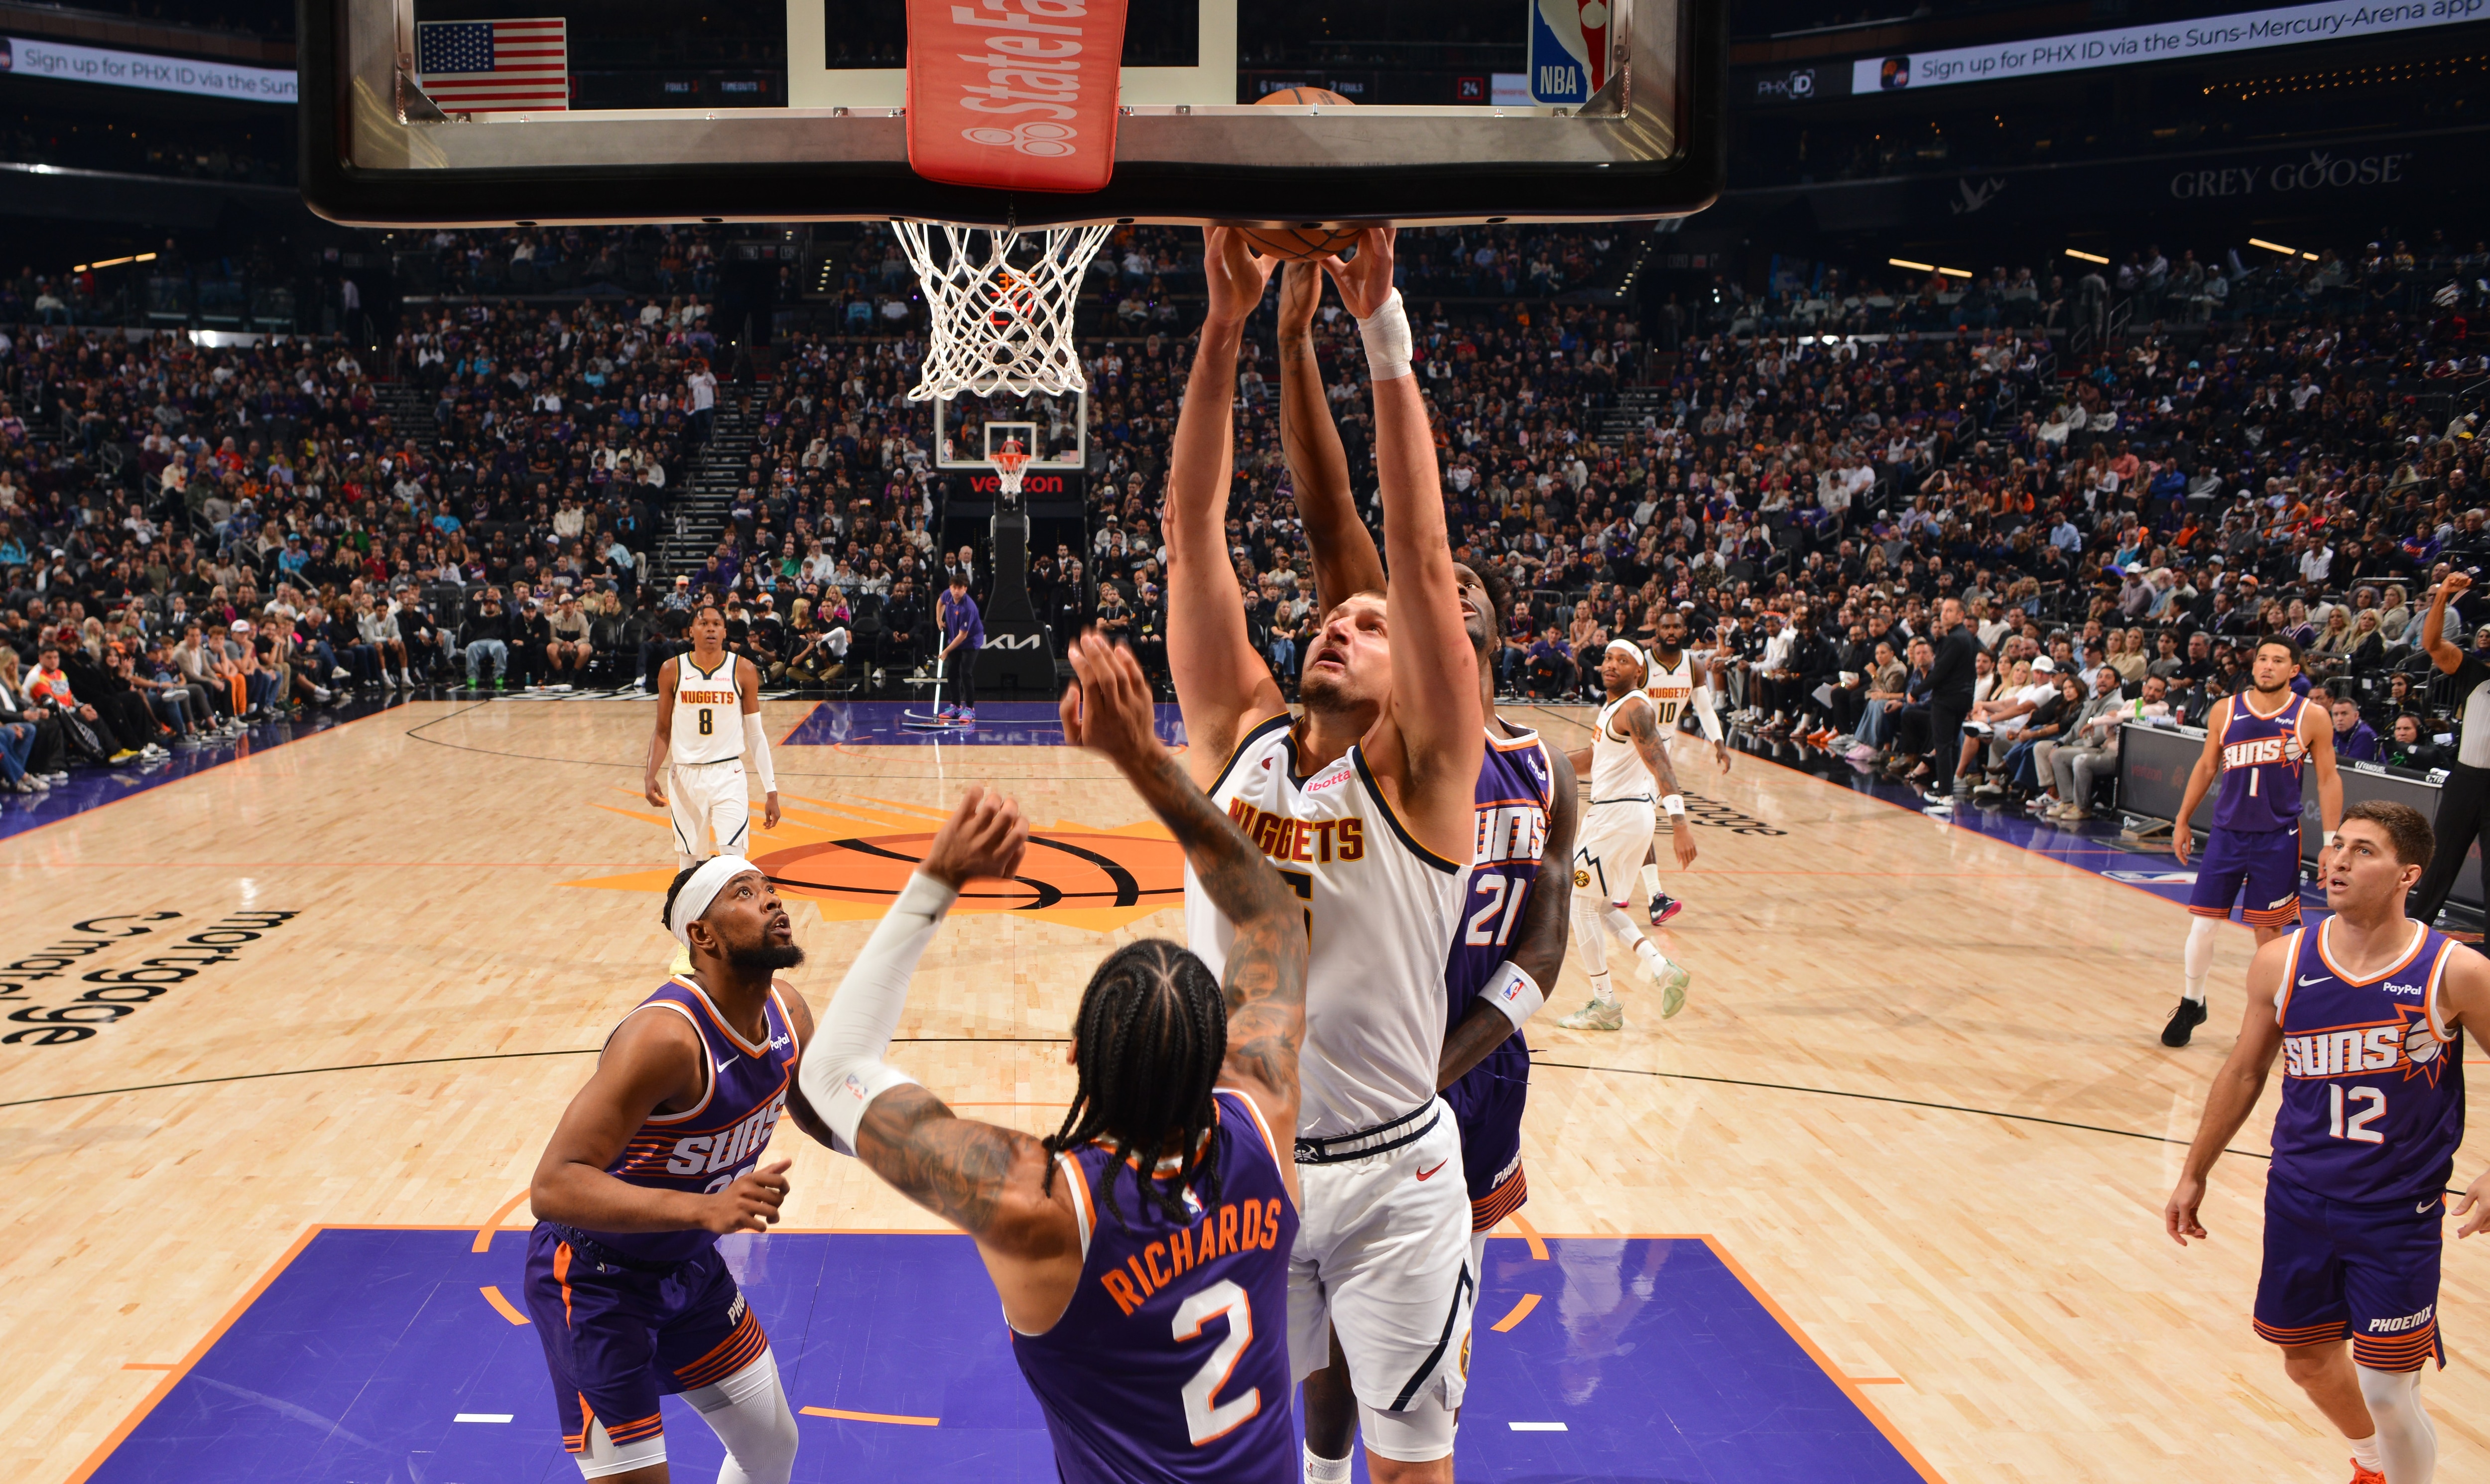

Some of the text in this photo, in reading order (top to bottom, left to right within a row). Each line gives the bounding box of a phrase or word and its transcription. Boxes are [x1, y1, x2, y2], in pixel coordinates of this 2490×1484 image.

[1922, 0, 2483, 81] Sign up for PHX ID via the Suns-Mercury-Arena app
[25, 49, 298, 95] Sign up for PHX ID via the Sun
[1540, 65, 1577, 95] NBA
[1339, 82, 1364, 93] FOULS
[1462, 81, 1479, 96] 24
[1757, 79, 1789, 96] PHX
[2170, 154, 2402, 200] GREY GOOSE
[970, 476, 1063, 493] vezon
[680, 690, 734, 705] NUGGETS
[1648, 687, 1690, 698] NUGGETS
[699, 708, 713, 736] 8
[1658, 702, 1677, 724] 10
[2274, 717, 2295, 725] PayPal
[2224, 739, 2281, 769] SUNS
[1307, 769, 1351, 792] ibotta
[2249, 767, 2259, 797] 1
[1475, 806, 1546, 865] UNS
[1466, 873, 1527, 946] 21
[1, 911, 301, 1045] mortgage
[2382, 982, 2422, 995] PayPal
[769, 1032, 790, 1051] PayPal
[2285, 1027, 2399, 1076] SUNS
[2328, 1083, 2387, 1144] 12
[666, 1091, 786, 1174] SUNS
[1101, 1197, 1282, 1317] RICHARDS
[2368, 1303, 2433, 1333] PHOENIX
[1171, 1277, 1261, 1446] 2
